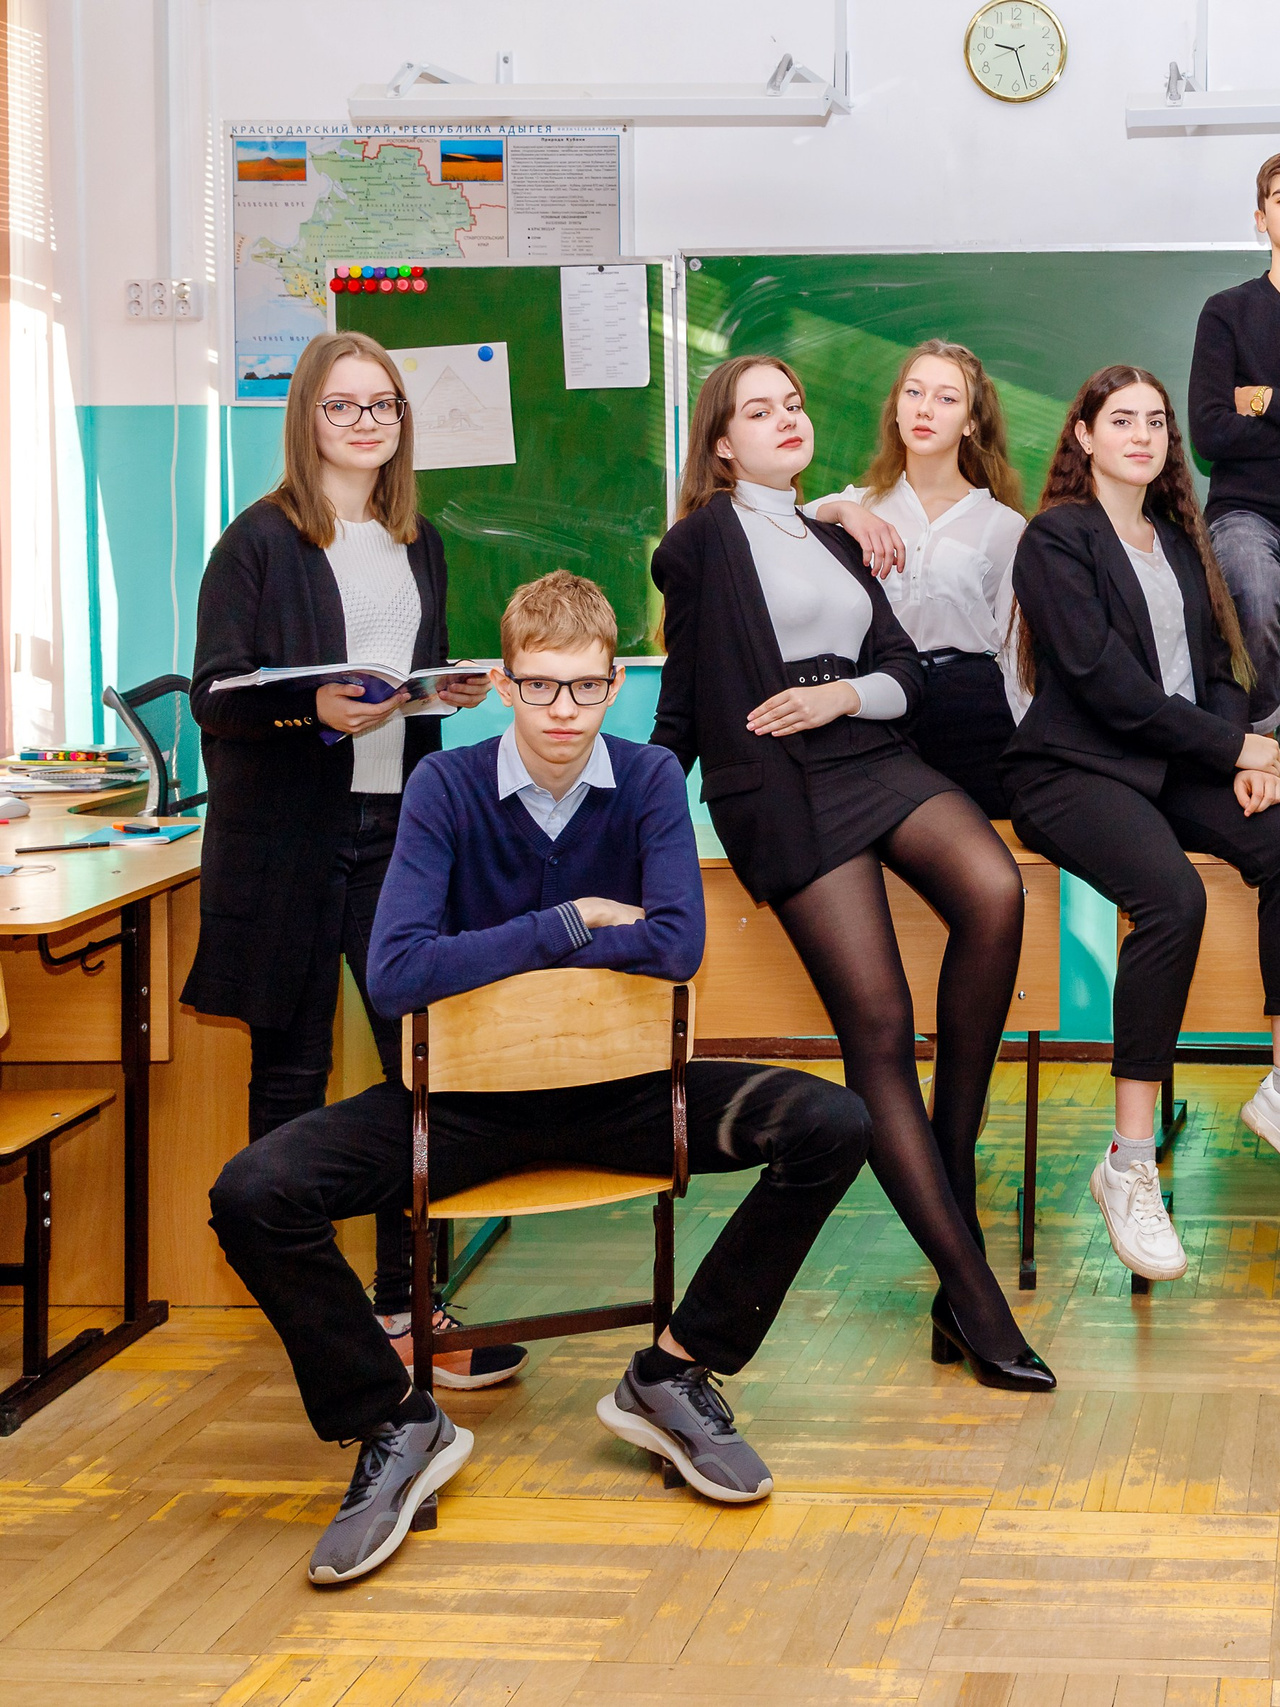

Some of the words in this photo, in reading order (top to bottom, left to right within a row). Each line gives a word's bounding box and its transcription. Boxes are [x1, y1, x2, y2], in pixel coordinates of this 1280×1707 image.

[996, 12, 1003, 24] 11
[1011, 7, 1022, 20] 12
[983, 26, 994, 39] 10
[1042, 26, 1051, 39] 2
[977, 43, 986, 55] 9
[1047, 43, 1055, 57] 3
[982, 61, 990, 74] 8
[1042, 62, 1050, 74] 4
[995, 74, 1003, 86] 7
[1011, 80, 1020, 92] 6
[1029, 75, 1038, 88] 5
[231, 124, 349, 136] КРАСНОДАРСКИЙ
[356, 124, 396, 134] КРАЙ,
[403, 125, 491, 134] РЕСПУБЛИКА
[499, 125, 552, 136] АДЫГЕЯ
